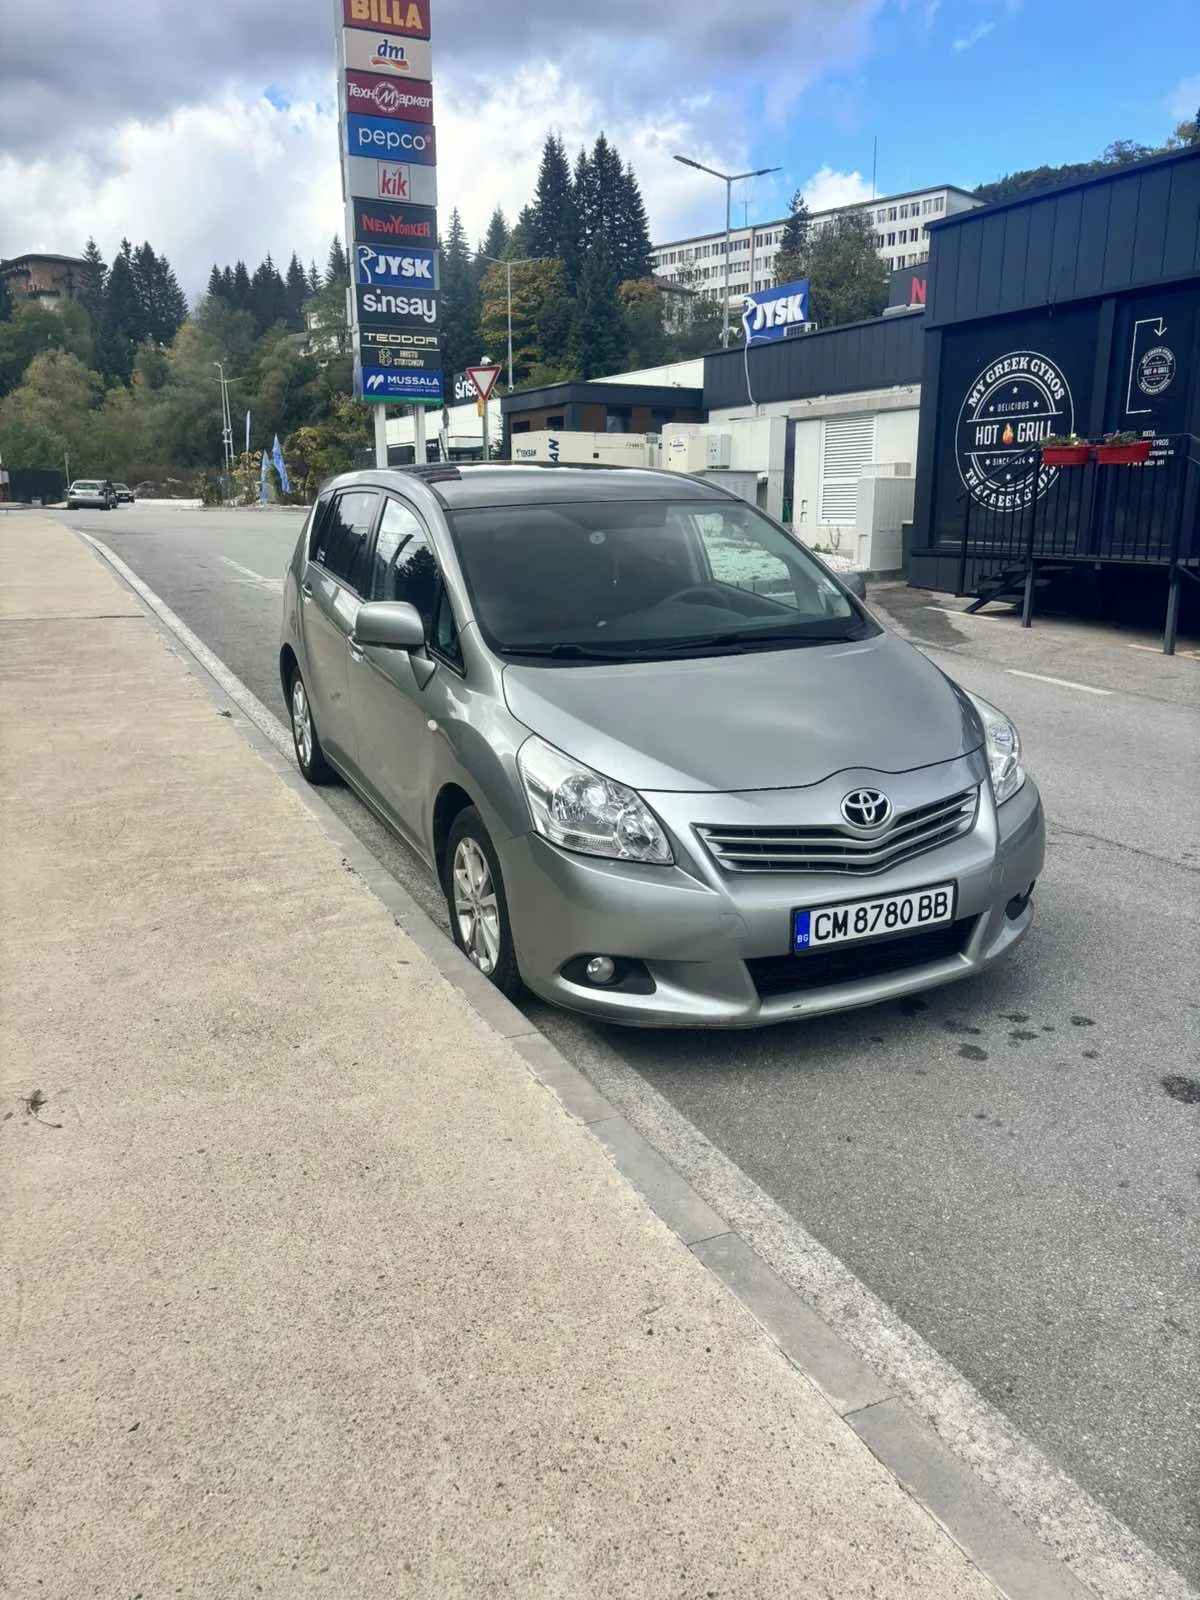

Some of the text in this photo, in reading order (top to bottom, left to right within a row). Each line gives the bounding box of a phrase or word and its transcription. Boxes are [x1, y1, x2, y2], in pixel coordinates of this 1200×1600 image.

[350, 0, 423, 31] BILLA
[377, 38, 405, 60] dm
[380, 167, 408, 197] kik
[374, 254, 433, 280] JYSK
[362, 289, 437, 324] sinsay
[752, 292, 806, 332] JYSK
[363, 332, 438, 345] TEODOR
[387, 375, 440, 387] MUSSALA
[966, 356, 1066, 409] MY GREEK GYROS
[996, 400, 1030, 413] DELICIOUS
[974, 419, 1057, 446] HOT GRILL
[814, 892, 948, 941] CM 8780 BB
[796, 934, 809, 944] BG
